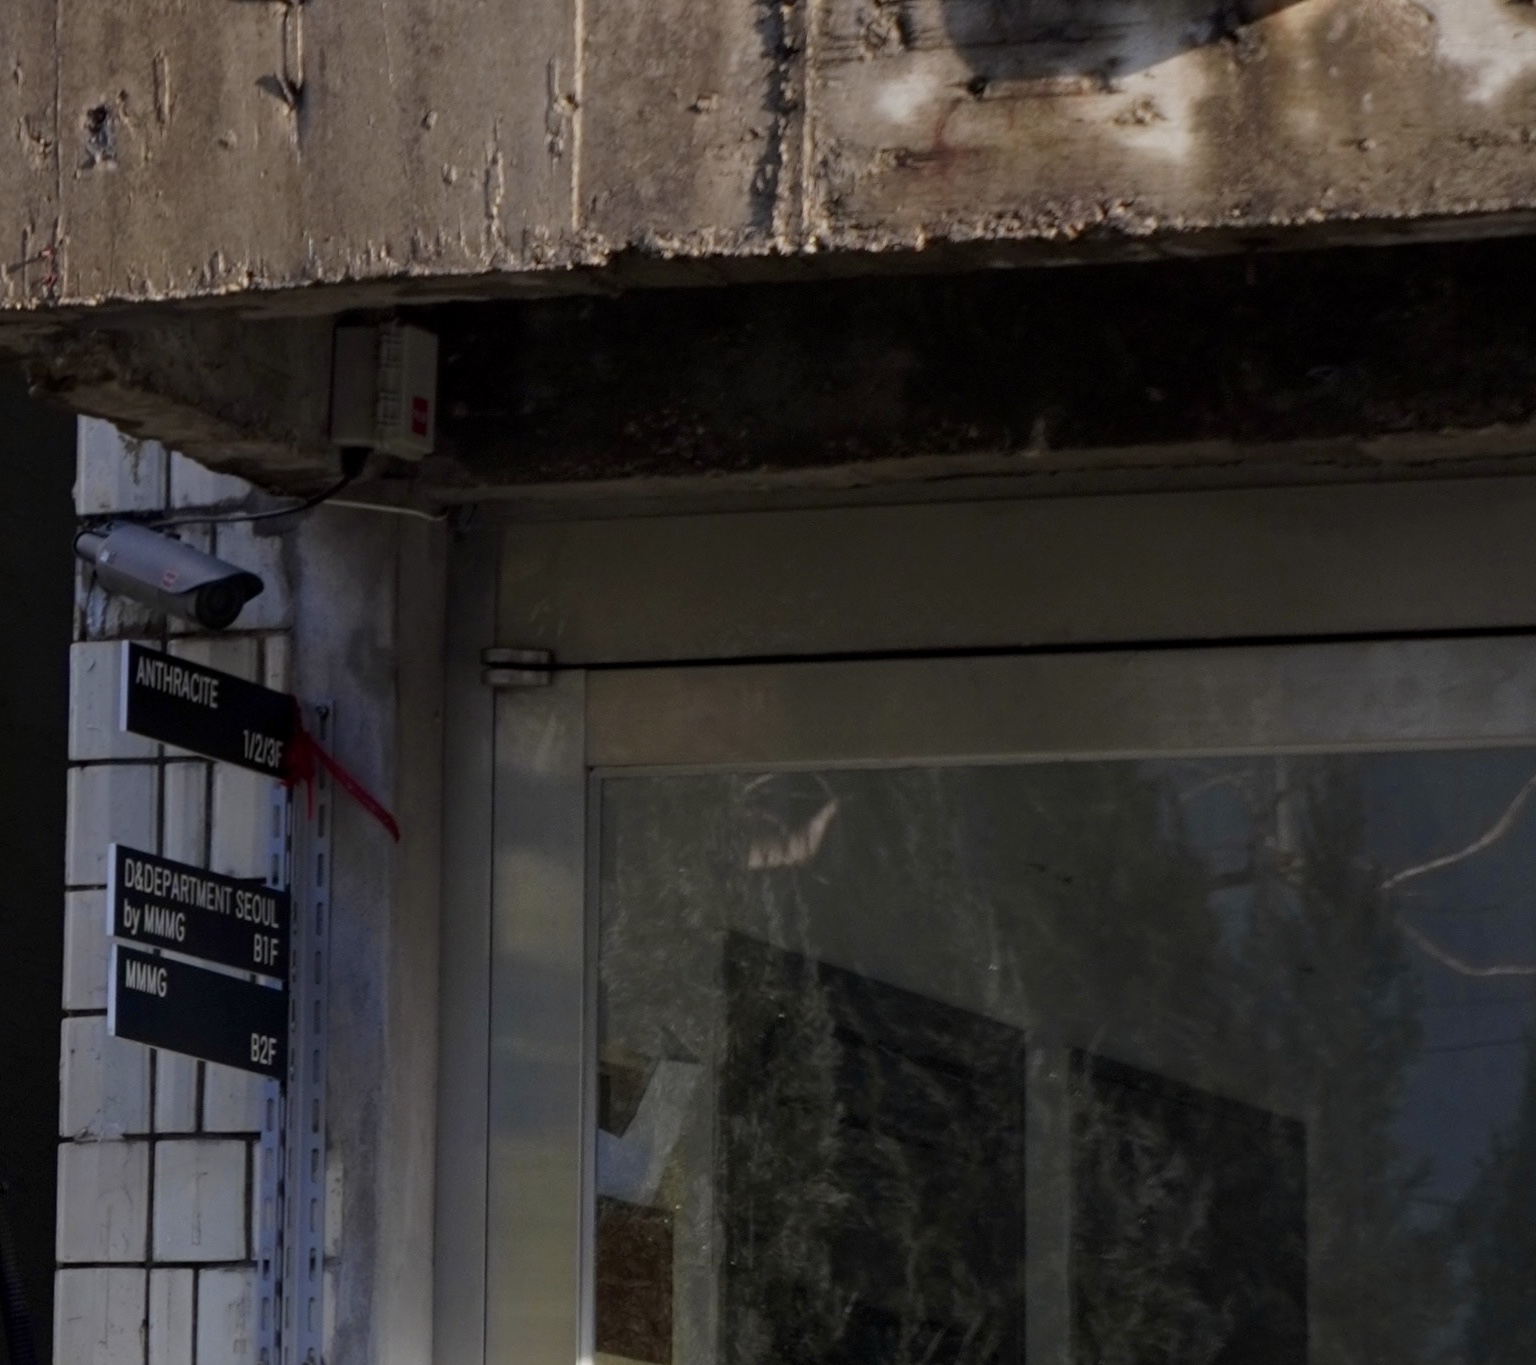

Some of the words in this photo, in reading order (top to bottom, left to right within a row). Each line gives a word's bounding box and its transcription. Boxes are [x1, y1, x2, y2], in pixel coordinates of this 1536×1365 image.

[135, 655, 220, 709] ANTHRACITE
[242, 729, 284, 769] 1/2/3F
[124, 857, 234, 915] D&DEPARTMENT
[235, 889, 280, 929] SEOUL
[122, 898, 142, 936] by
[143, 903, 186, 942] MMMG
[252, 932, 280, 967] B1F
[124, 958, 168, 998] MMMG
[249, 1032, 278, 1067] B2F
